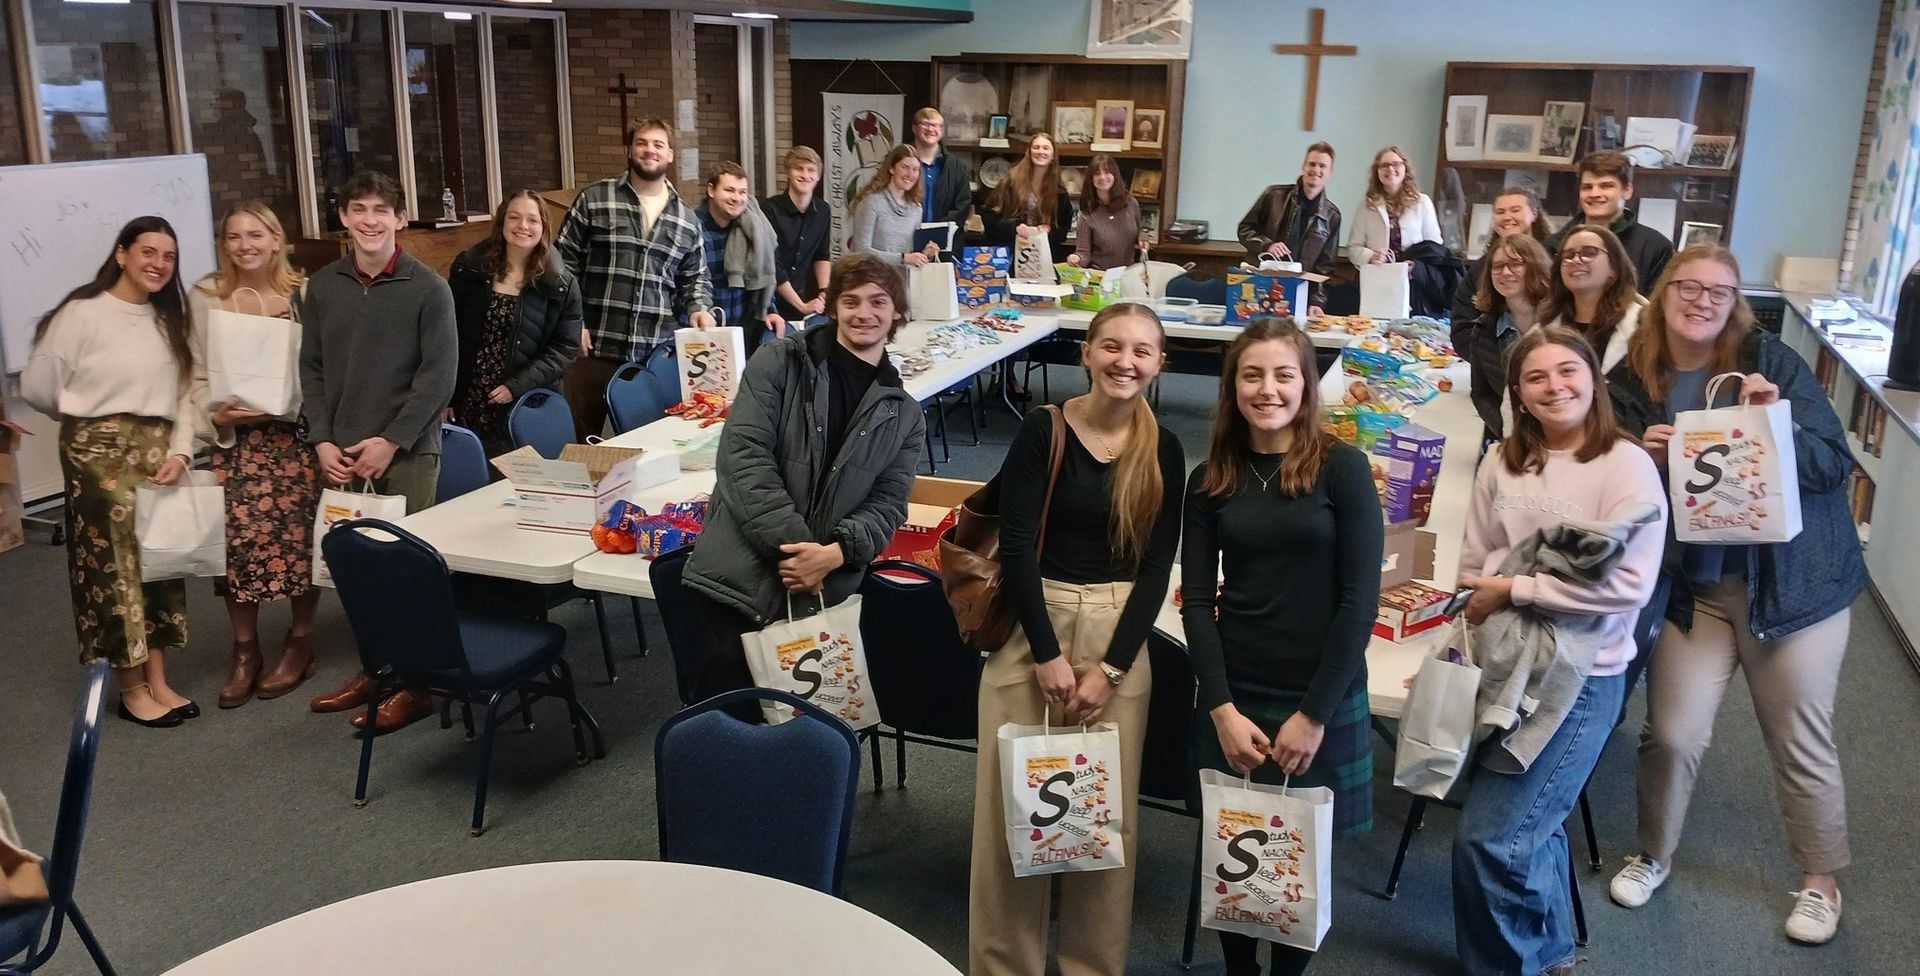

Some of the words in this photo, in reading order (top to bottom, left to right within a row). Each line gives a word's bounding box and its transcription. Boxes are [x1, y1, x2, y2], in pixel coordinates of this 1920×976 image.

[830, 104, 842, 158] ALWAYS
[831, 163, 843, 208] CHRIST
[10, 226, 42, 268] Hi
[687, 350, 710, 378] S
